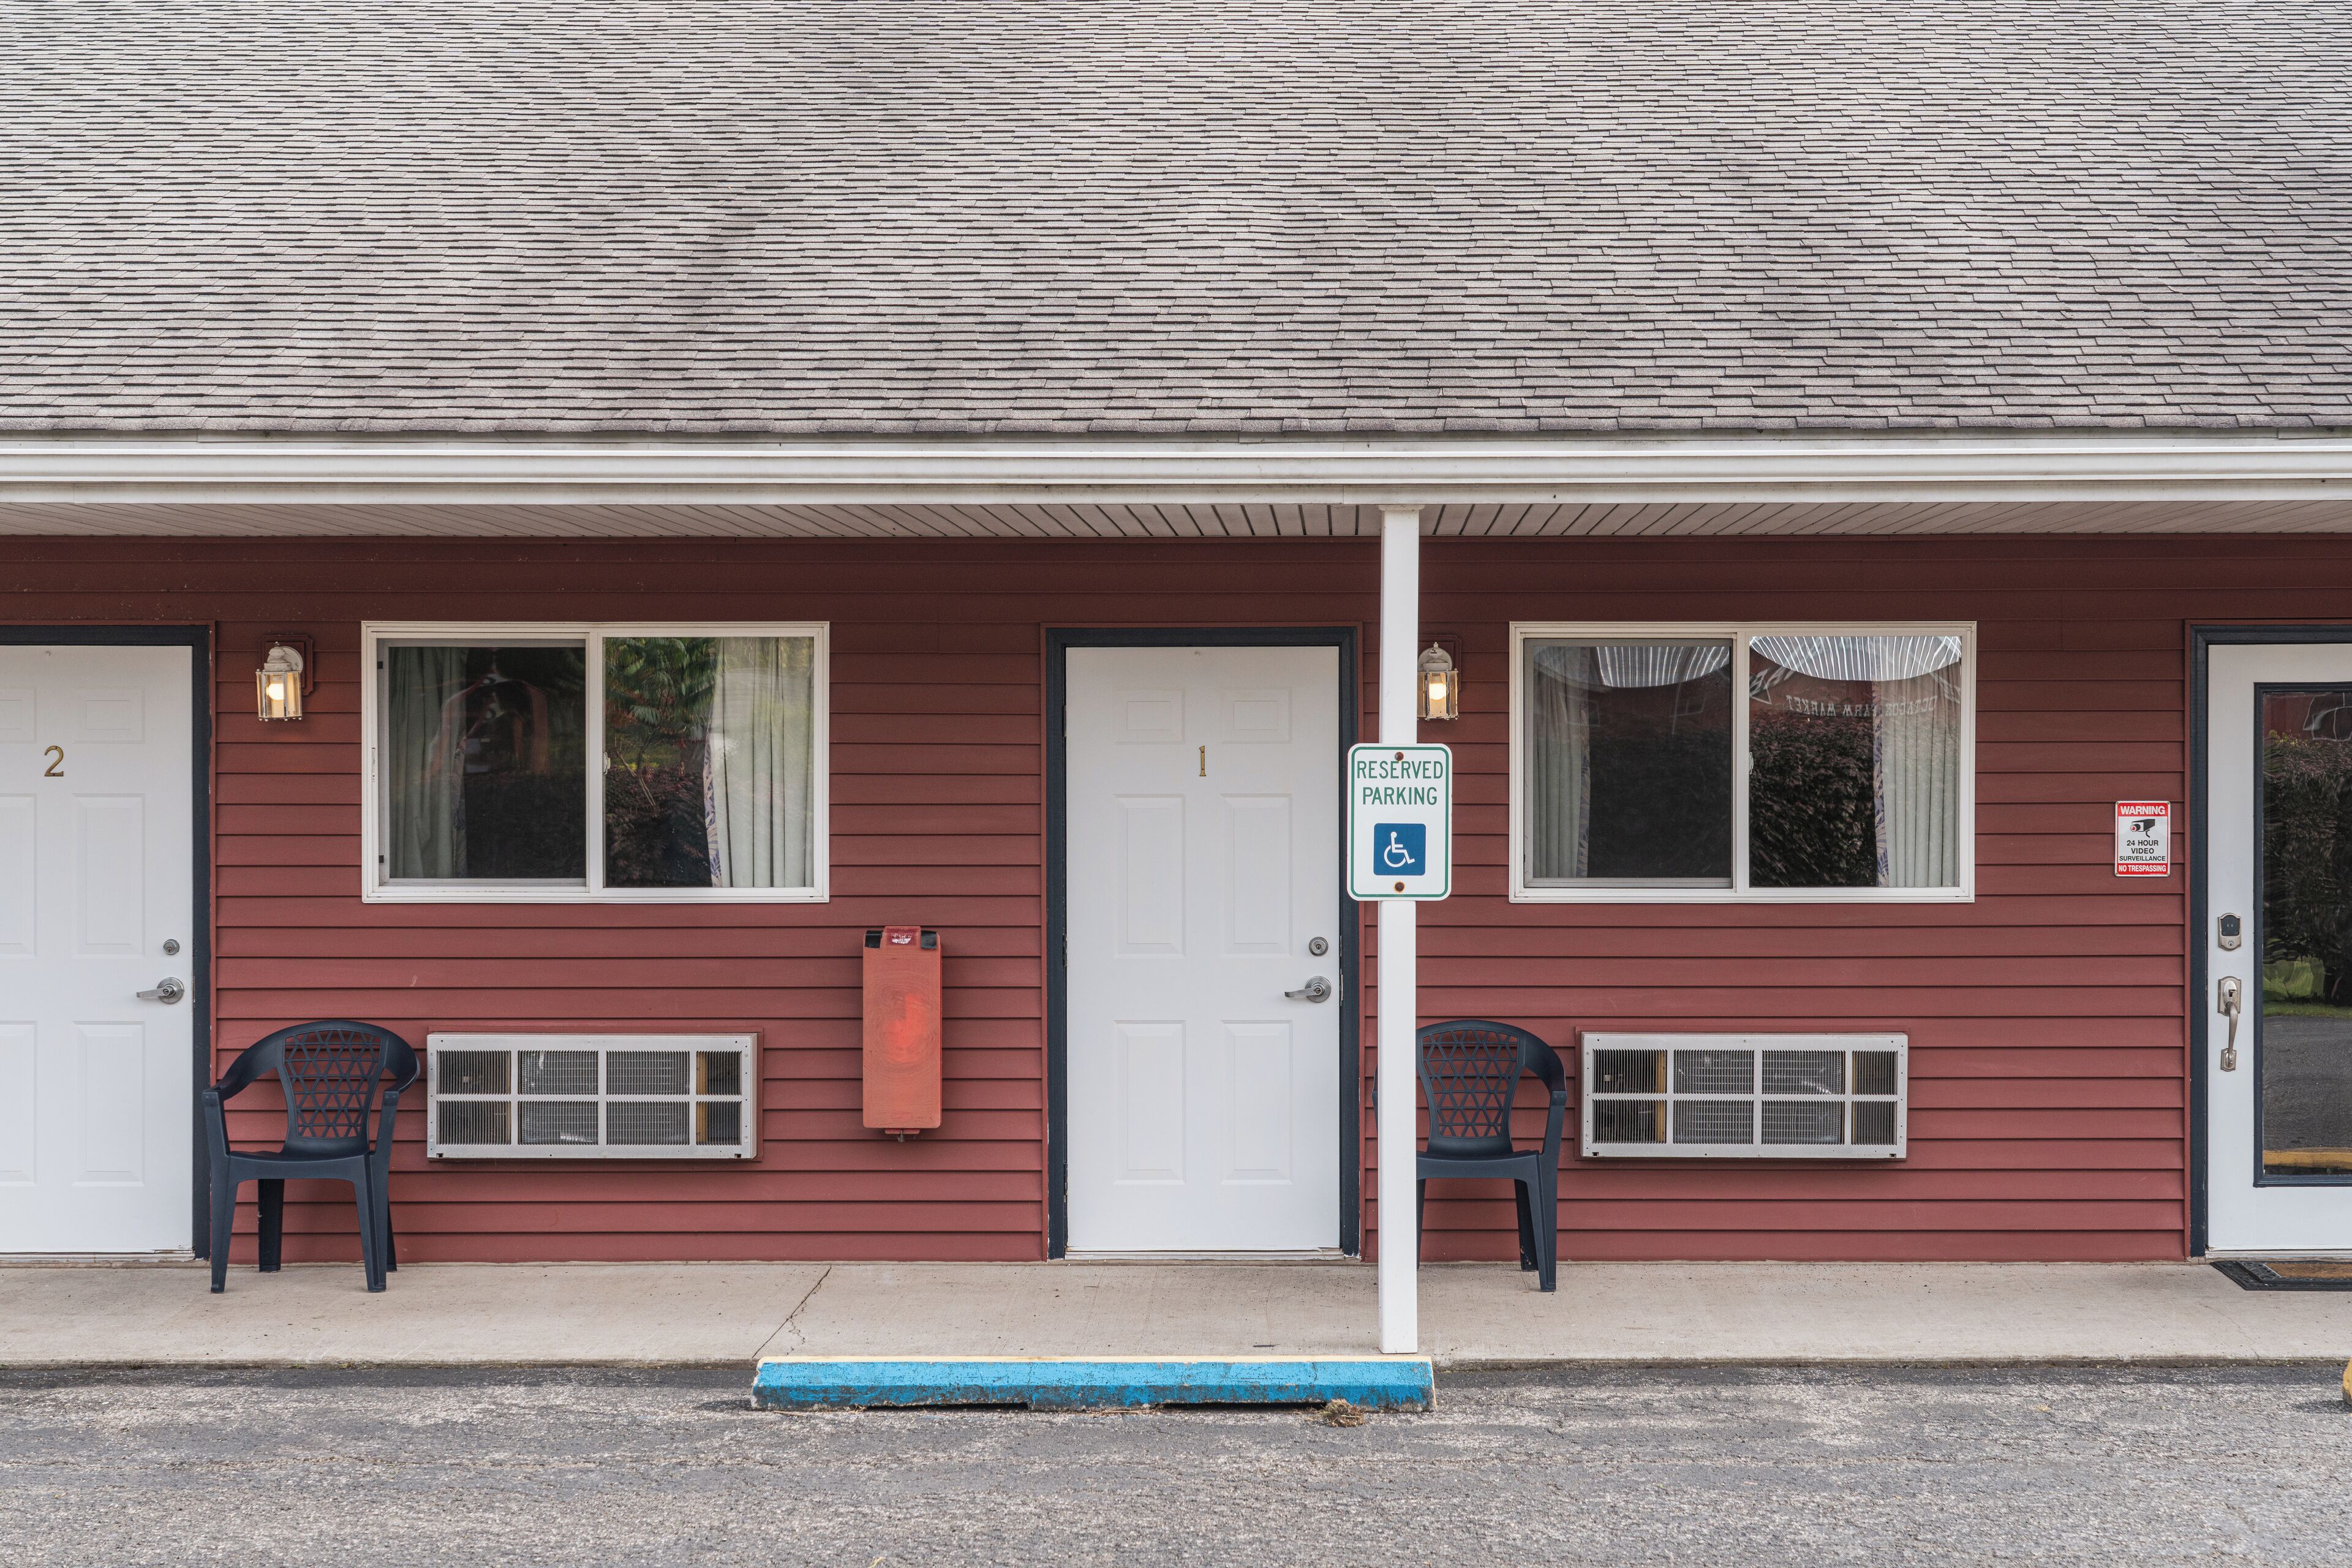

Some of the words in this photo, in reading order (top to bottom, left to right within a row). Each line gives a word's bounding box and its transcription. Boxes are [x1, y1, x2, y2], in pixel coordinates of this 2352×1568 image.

[44, 745, 64, 777] 2
[1199, 745, 1207, 777] 1
[1357, 761, 1443, 779] RESERVED
[1363, 786, 1438, 805] PARKING
[2120, 805, 2165, 815] WARNING
